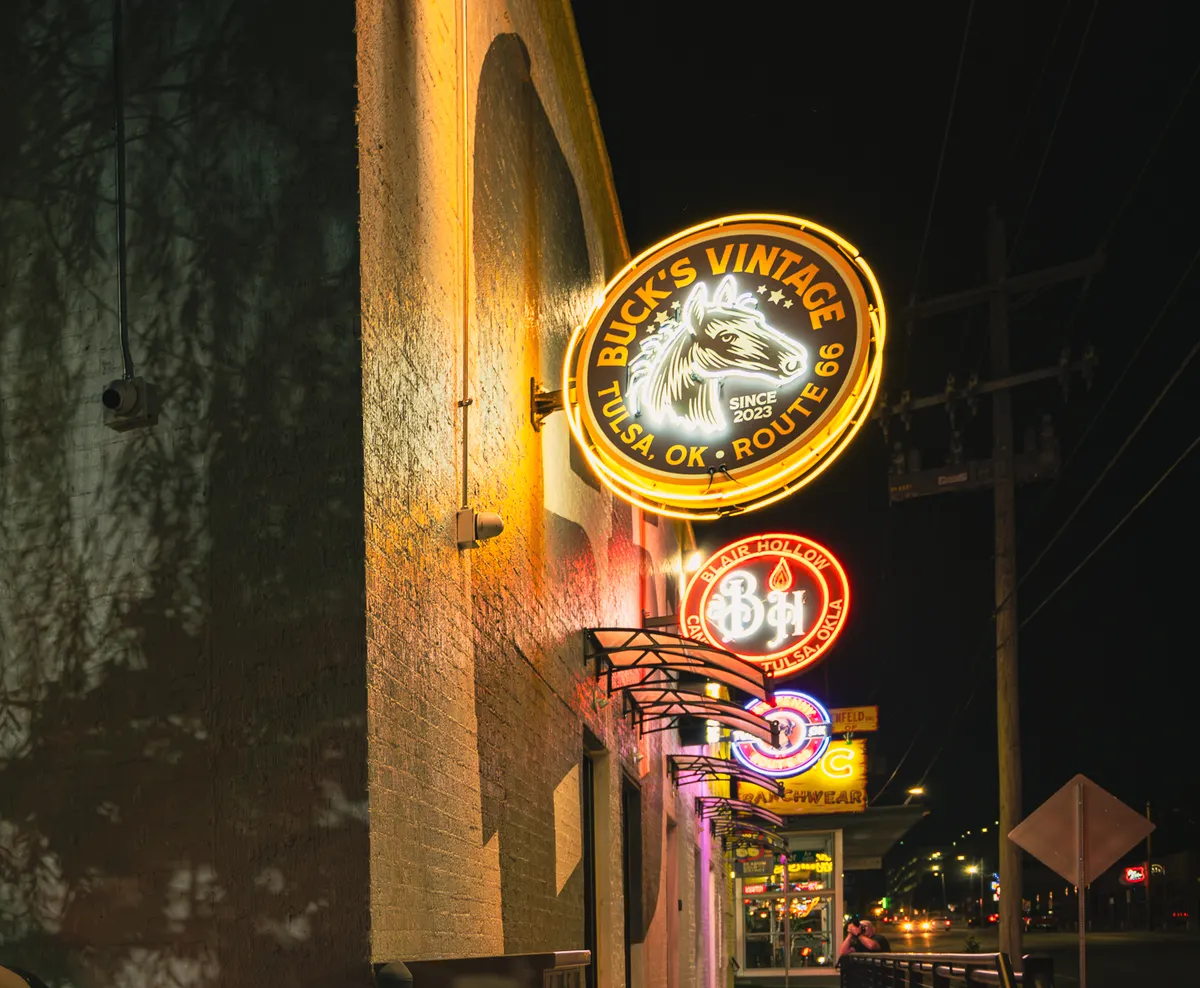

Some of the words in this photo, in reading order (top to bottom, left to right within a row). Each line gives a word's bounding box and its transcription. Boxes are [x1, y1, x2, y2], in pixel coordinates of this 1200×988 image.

[597, 256, 697, 367] BUCK'S
[705, 243, 846, 330] VINTAGE
[598, 380, 655, 461] TULSA,
[665, 444, 709, 467] OK
[729, 391, 777, 410] SINCE
[732, 382, 828, 460] ROUTE
[815, 343, 844, 376] 66
[733, 405, 773, 423] 2023
[700, 545, 750, 583] BLAIR
[757, 539, 831, 571] HOLLOW
[687, 614, 710, 644] CAN
[761, 644, 820, 673] TULSA,
[817, 599, 843, 641] OKLA
